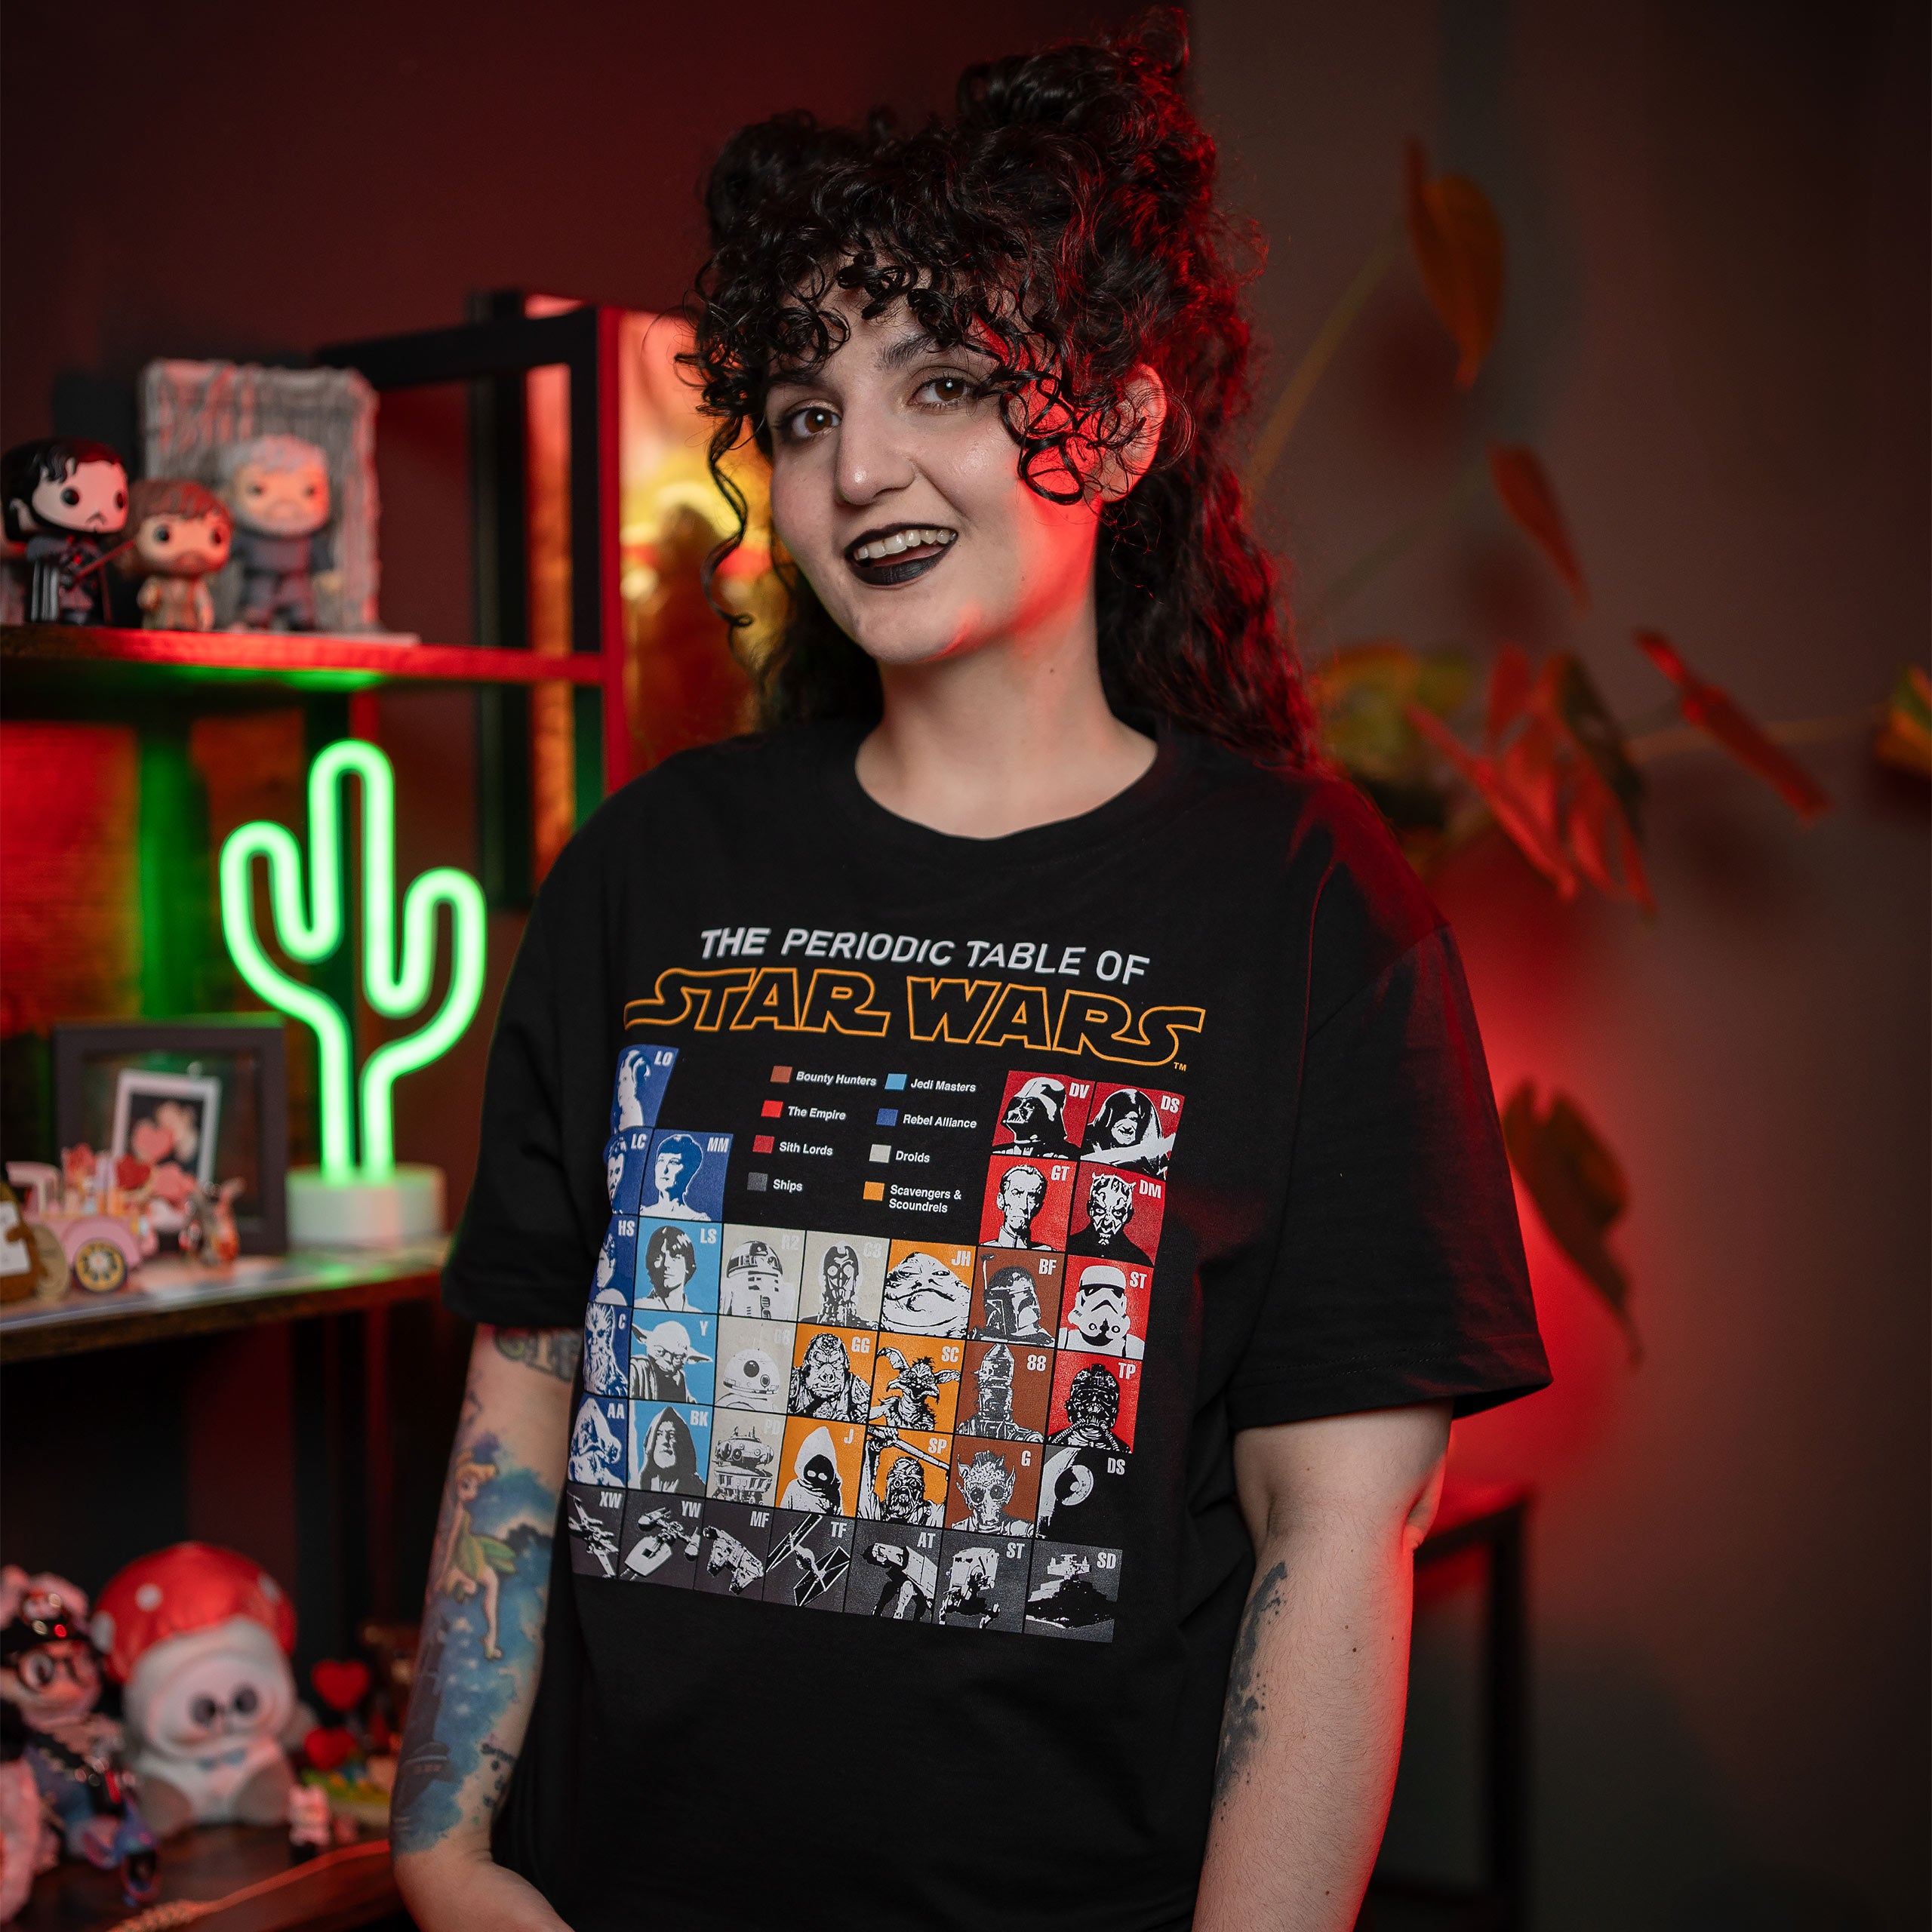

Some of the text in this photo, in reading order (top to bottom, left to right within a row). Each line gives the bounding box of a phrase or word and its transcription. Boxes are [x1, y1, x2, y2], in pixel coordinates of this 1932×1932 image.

[700, 928, 1150, 985] THE PERIODIC TABLE OF
[623, 967, 1206, 1066] STAR WARS
[654, 1051, 673, 1066] LO
[796, 1071, 877, 1086] Bounty Hunters
[911, 1078, 977, 1093] Jedi Masters
[1069, 1082, 1090, 1099] DV
[1160, 1096, 1180, 1113] DS
[788, 1106, 846, 1121] The Empire
[903, 1114, 977, 1128] Rebel Alliance
[631, 1134, 648, 1149] LC
[707, 1137, 730, 1153] MM
[779, 1142, 833, 1155] Sith Lords
[895, 1151, 930, 1163] Droids
[1051, 1165, 1070, 1181] GT
[773, 1179, 803, 1193] Ships
[890, 1185, 961, 1200] Scavengers &
[1139, 1180, 1161, 1198] DM
[889, 1198, 948, 1213] Scoundrels
[618, 1220, 635, 1236] HS
[700, 1229, 716, 1244] LS
[781, 1234, 799, 1250] R2
[863, 1241, 882, 1258] C3
[951, 1251, 971, 1266] JH
[1038, 1259, 1057, 1275] BF
[1129, 1272, 1147, 1288] ST
[618, 1314, 625, 1329] C
[700, 1321, 709, 1336] Y
[851, 1337, 870, 1353] GG
[941, 1346, 959, 1362] SC
[1027, 1355, 1046, 1372] 88
[1118, 1362, 1136, 1380] TP
[607, 1403, 624, 1419] AA
[690, 1411, 709, 1426] BK
[844, 1429, 854, 1444] J
[928, 1438, 947, 1454] SP
[1021, 1451, 1032, 1467] G
[1107, 1457, 1125, 1475] DS
[599, 1491, 622, 1509] XW
[681, 1501, 702, 1518] YW
[749, 1511, 771, 1528] MF
[830, 1521, 848, 1538] TF
[917, 1532, 936, 1549] AT
[1006, 1543, 1025, 1559] ST
[1097, 1552, 1116, 1569] SD
